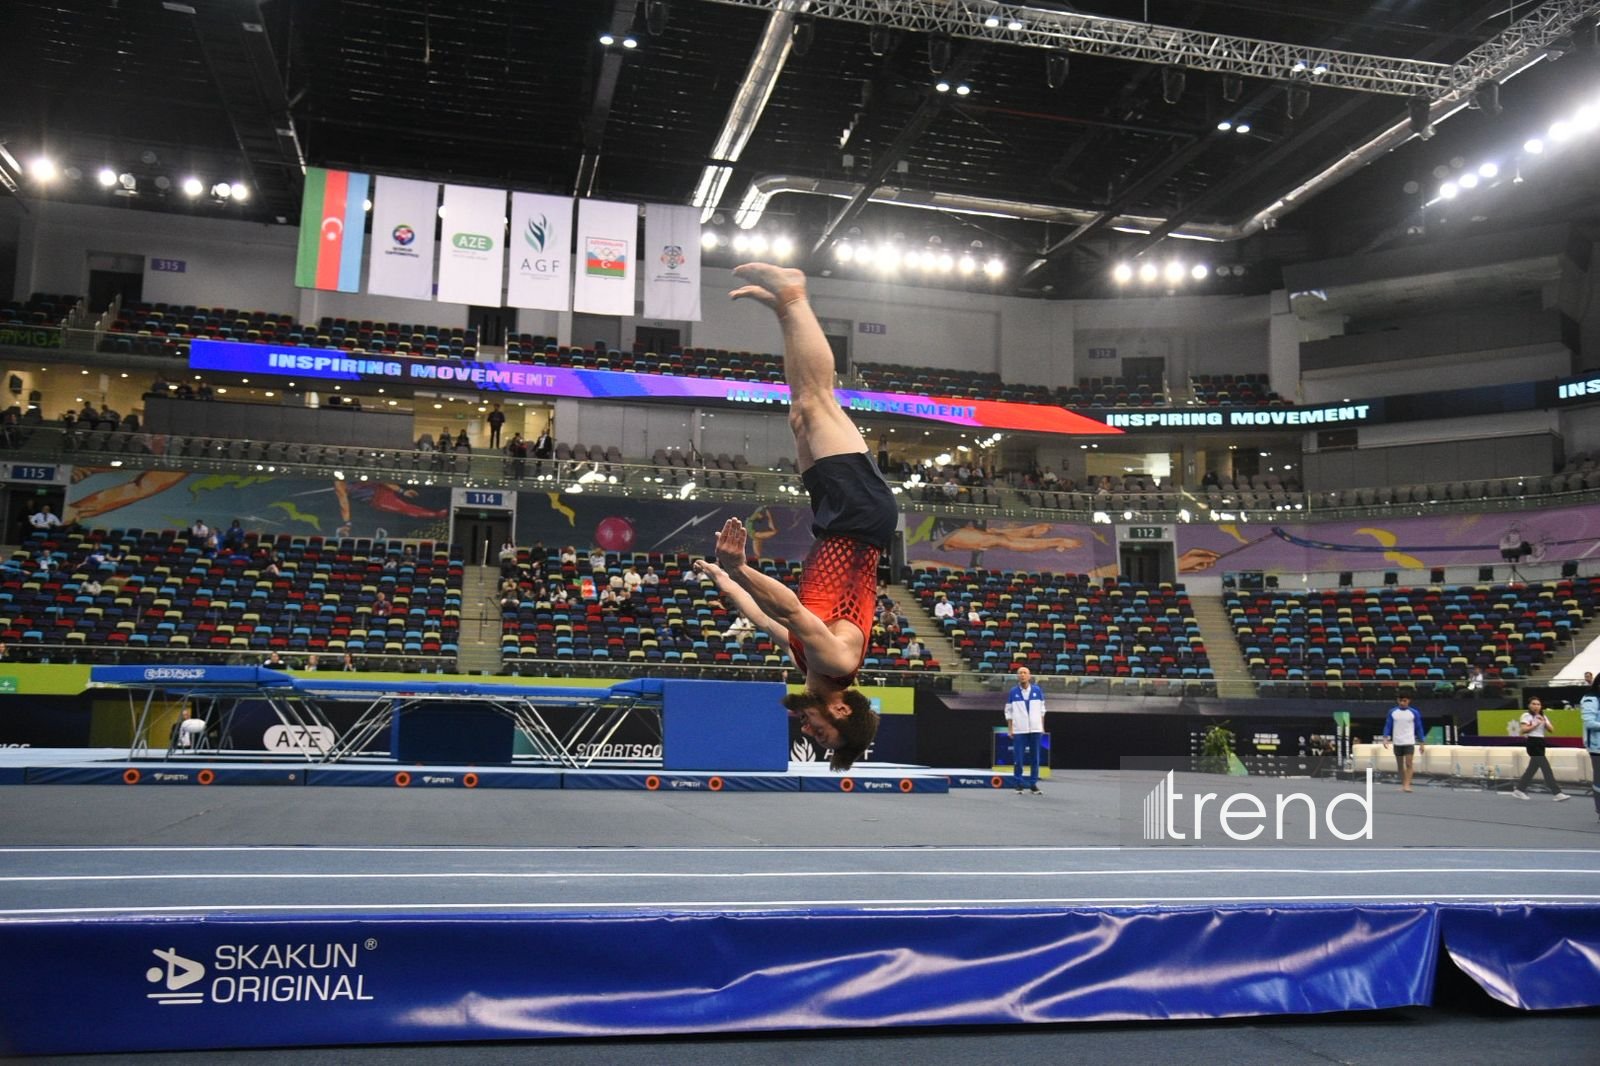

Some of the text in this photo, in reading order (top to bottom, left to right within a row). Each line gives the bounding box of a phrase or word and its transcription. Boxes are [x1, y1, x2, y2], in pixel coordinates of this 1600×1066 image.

[459, 235, 487, 249] AZE
[160, 261, 179, 271] 315
[269, 353, 556, 387] INSPIRING MOVEMENT
[1558, 379, 1600, 399] INS
[849, 397, 976, 418] MOVEMENT
[1106, 405, 1369, 427] INSPIRING MOVEMENT
[23, 467, 46, 479] 115
[475, 493, 494, 504] 114
[1137, 528, 1155, 537] 112
[276, 731, 321, 748] AZE
[214, 943, 358, 970] SKAKUN
[211, 974, 374, 1003] ORIGINAL
